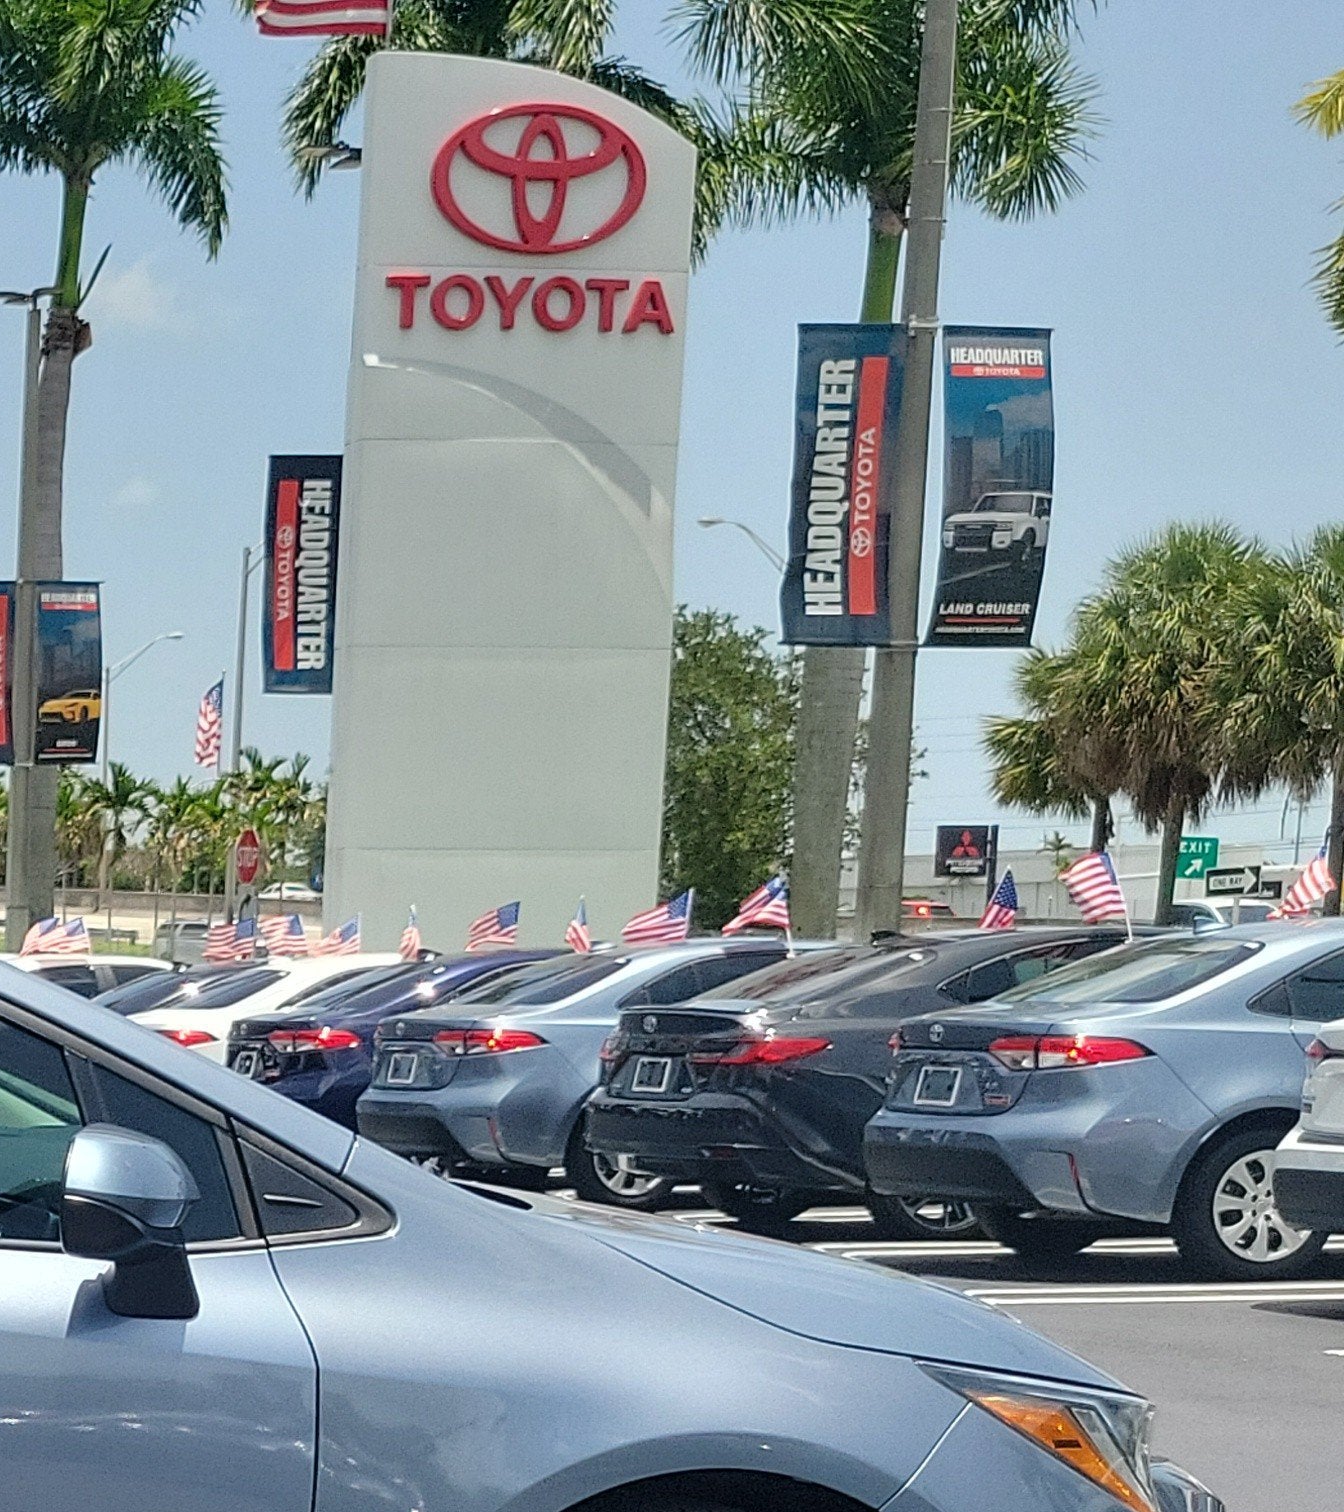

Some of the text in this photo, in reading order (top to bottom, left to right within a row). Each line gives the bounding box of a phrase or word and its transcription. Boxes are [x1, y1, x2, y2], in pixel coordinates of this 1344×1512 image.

[386, 274, 675, 335] TOYOTA
[950, 347, 1043, 366] HEADQUARTER
[803, 358, 857, 616] HEADQUARTER
[853, 426, 877, 525] TOYOTA
[276, 553, 292, 621] TOYOTA
[294, 479, 332, 670] HEADQUARTER
[939, 602, 1031, 615] LAND CRUISER
[1180, 841, 1212, 854] EXIT
